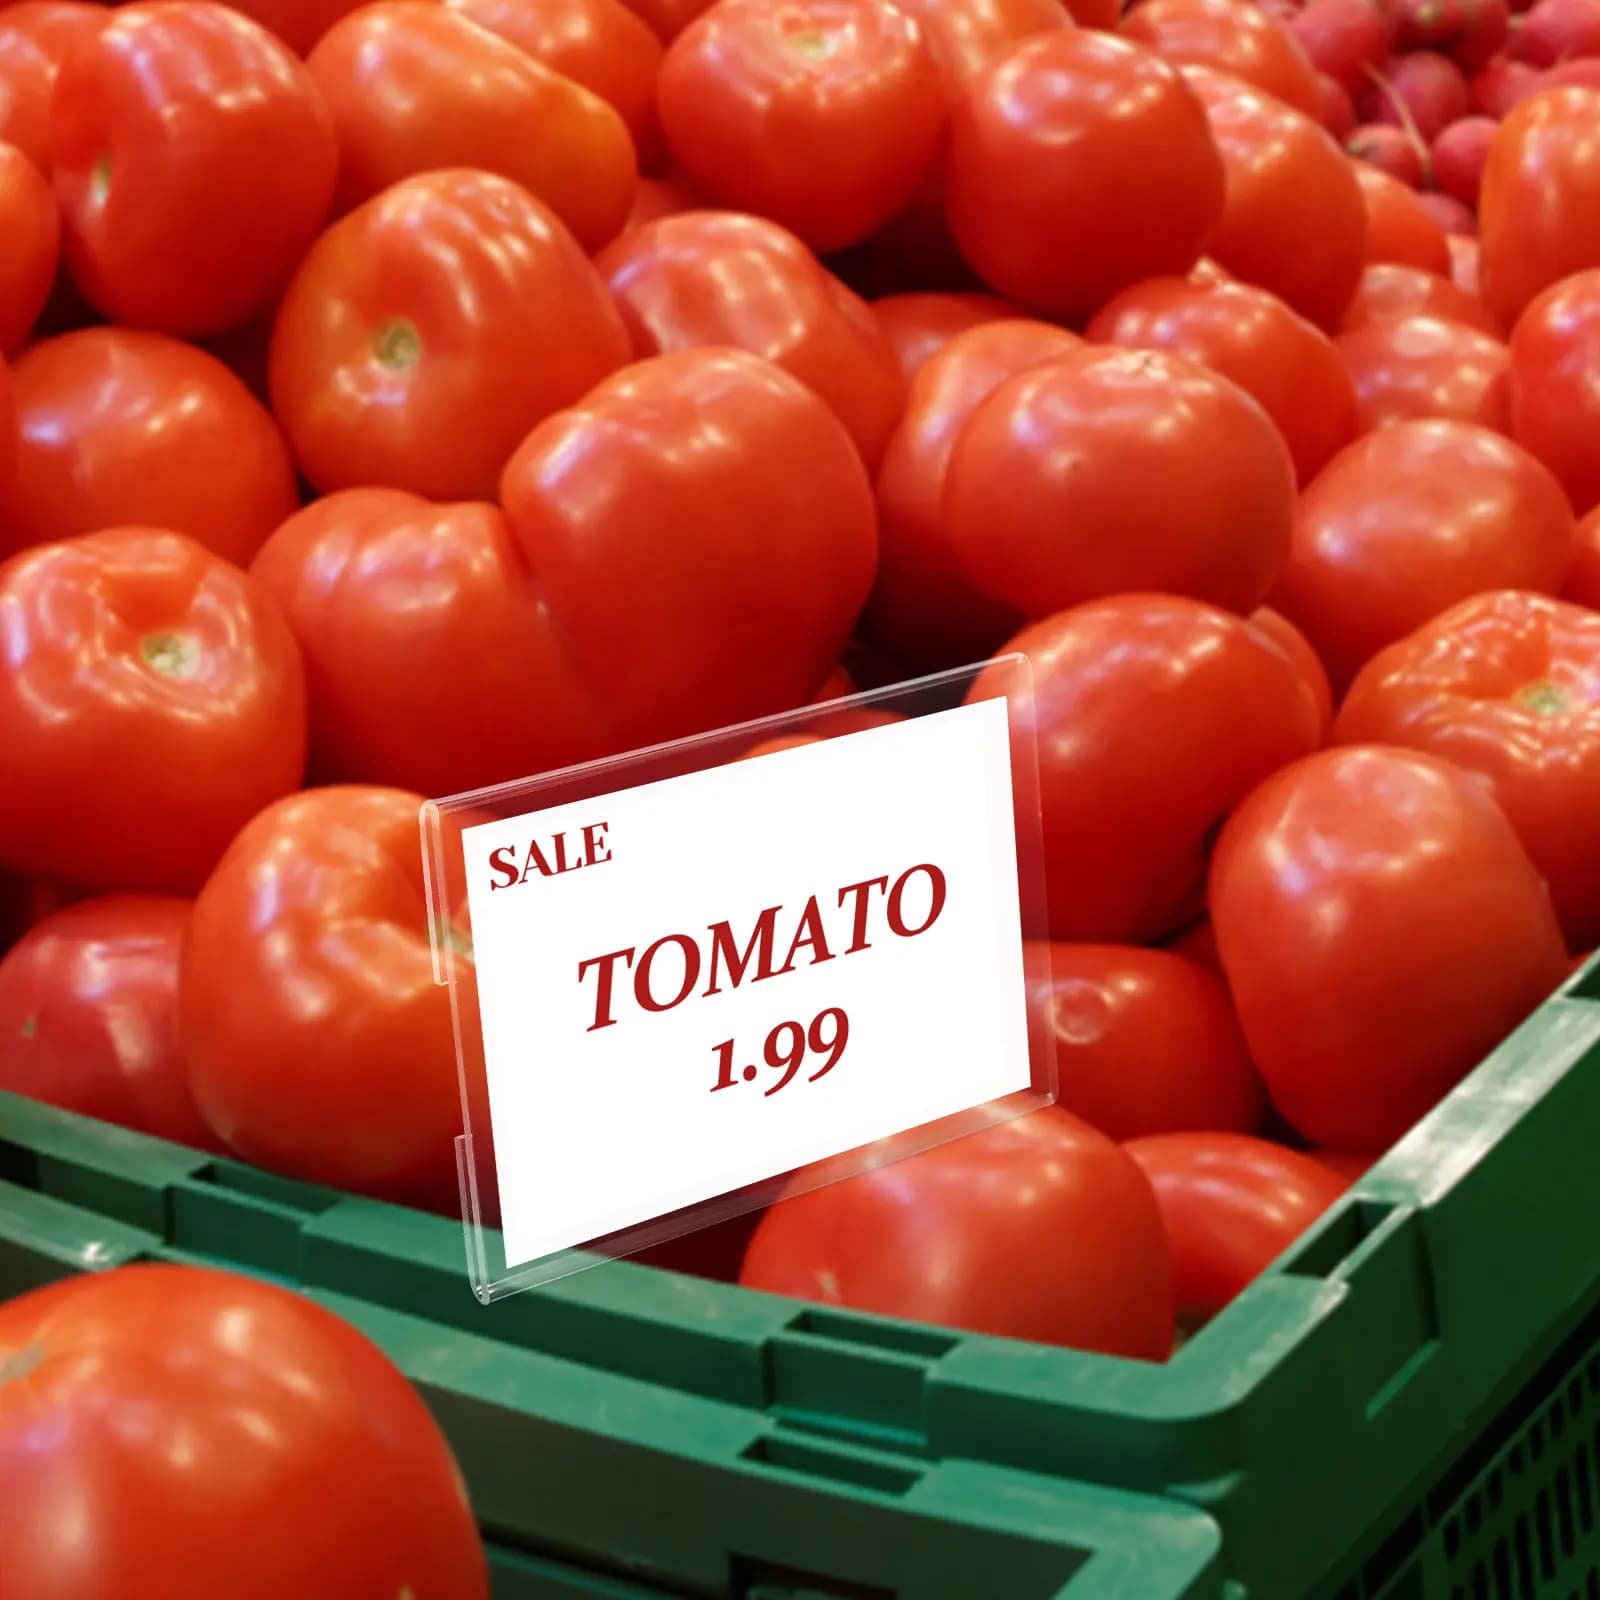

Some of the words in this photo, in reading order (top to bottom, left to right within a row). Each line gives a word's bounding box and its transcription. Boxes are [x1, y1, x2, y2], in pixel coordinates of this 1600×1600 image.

[488, 821, 613, 891] SALE
[578, 863, 947, 1033] TOMATO
[709, 1007, 850, 1098] 1.99
